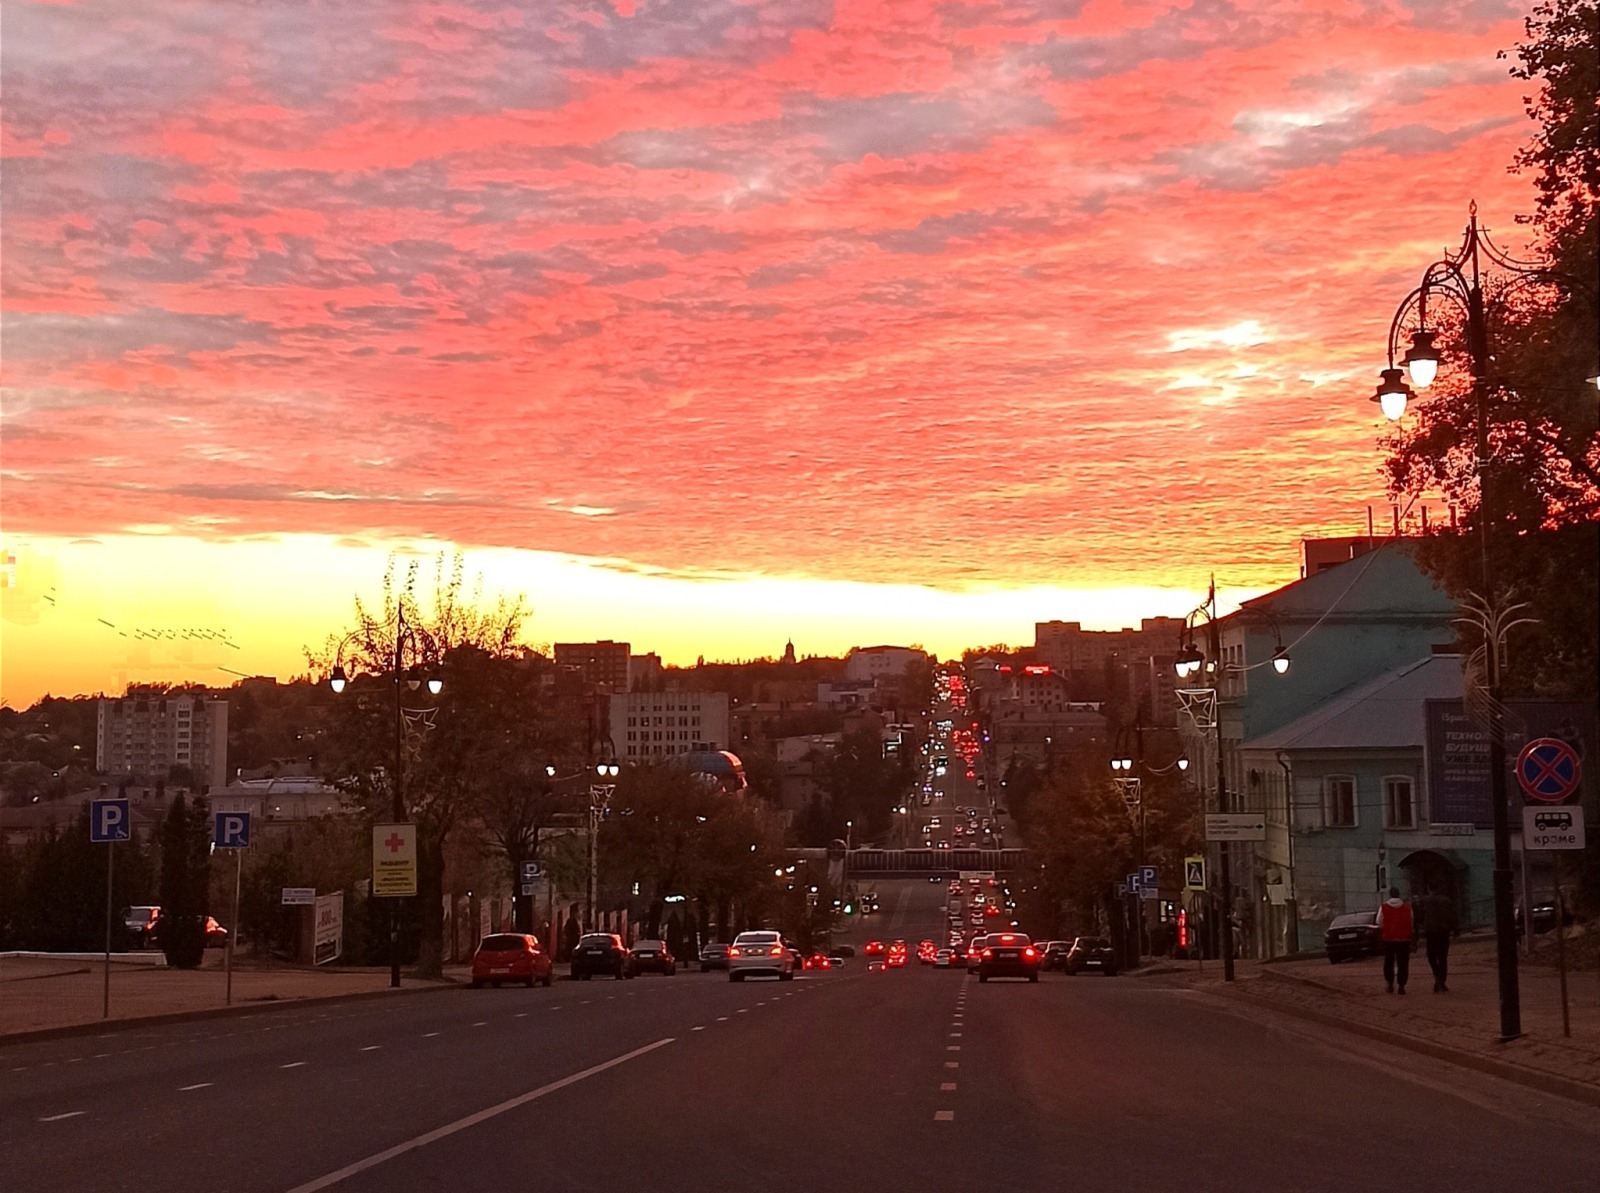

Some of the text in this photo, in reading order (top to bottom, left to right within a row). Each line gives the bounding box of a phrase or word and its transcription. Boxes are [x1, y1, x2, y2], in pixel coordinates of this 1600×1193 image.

[101, 805, 122, 836] P
[224, 817, 244, 843] P
[1533, 834, 1576, 846] кроме
[1143, 869, 1154, 883] P
